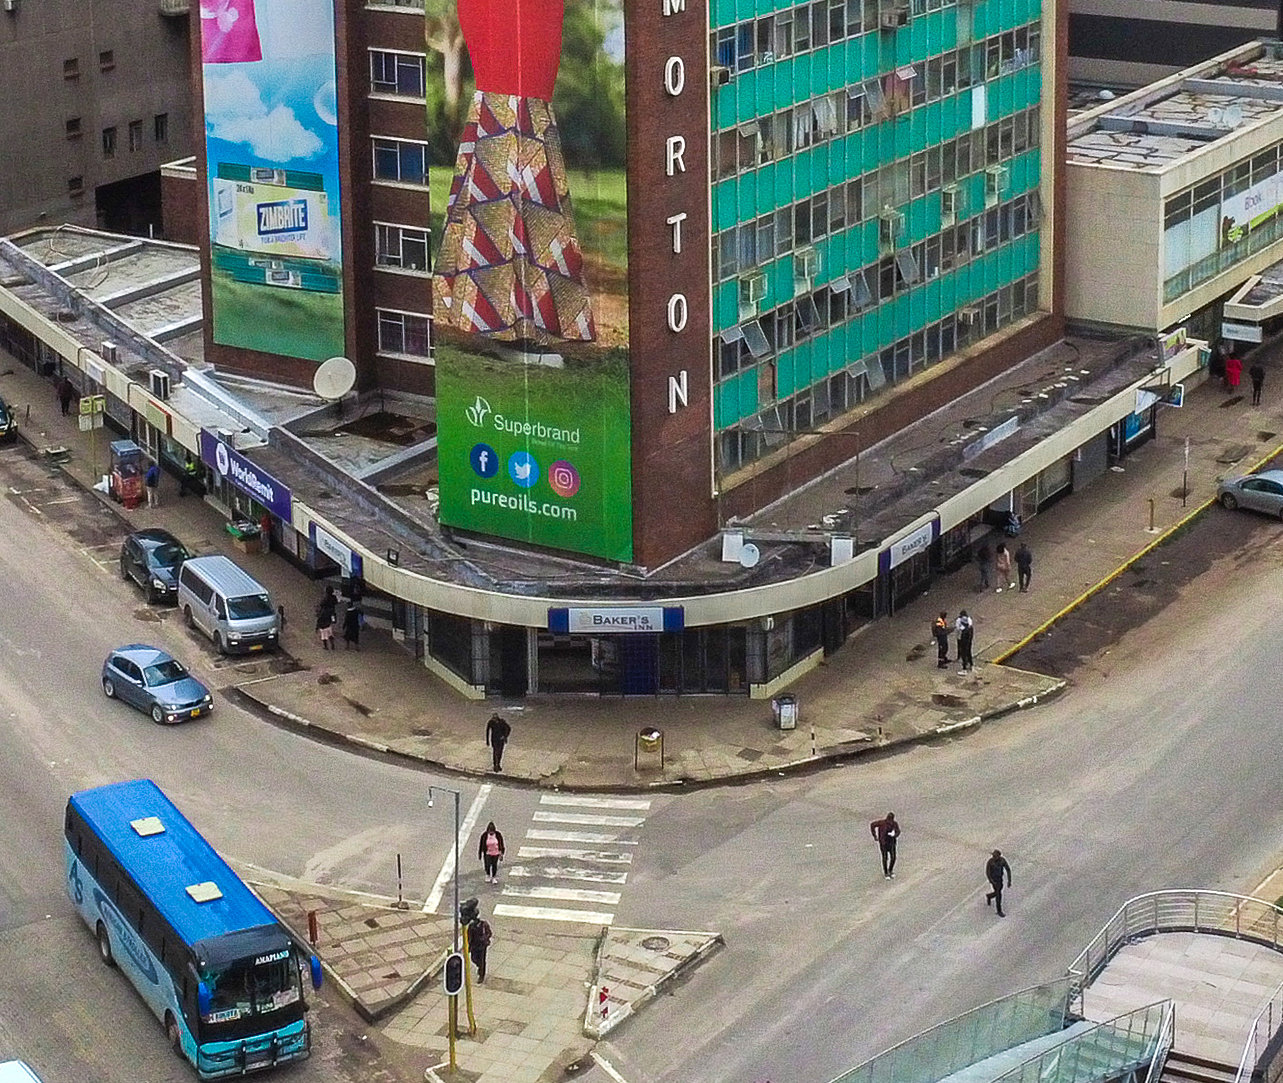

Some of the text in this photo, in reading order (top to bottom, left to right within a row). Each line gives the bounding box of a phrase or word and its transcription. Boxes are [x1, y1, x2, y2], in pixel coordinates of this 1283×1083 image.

[259, 203, 306, 232] ZIMBRITE
[494, 414, 580, 443] Superbrand
[471, 488, 577, 521] pureoils.com
[593, 615, 649, 625] BAKER'S
